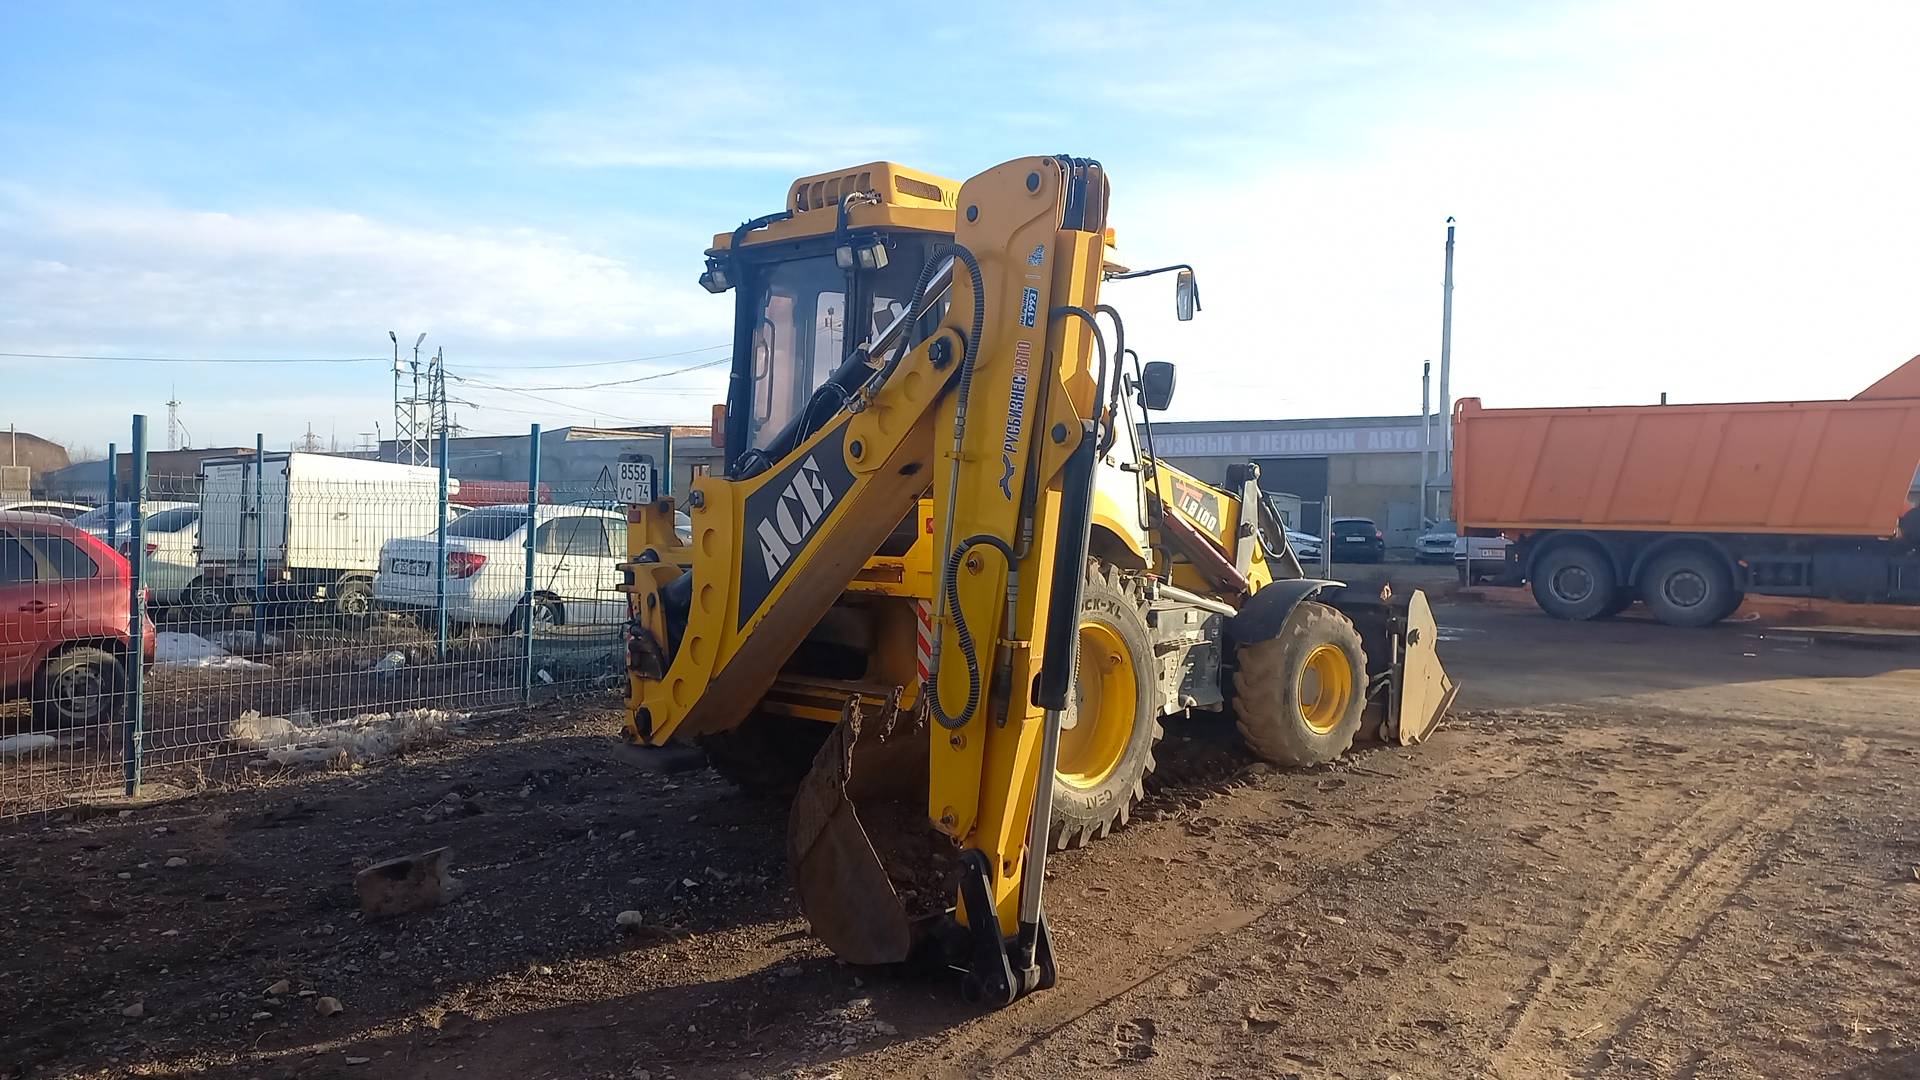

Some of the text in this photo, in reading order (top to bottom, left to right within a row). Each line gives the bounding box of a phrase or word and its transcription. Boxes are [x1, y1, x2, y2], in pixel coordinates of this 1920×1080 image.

[1004, 341, 1032, 453] РУСБИЗНЕСАВТО
[1155, 435, 1233, 454] РУЗОВЫХ
[1368, 430, 1417, 449] АВТО
[621, 464, 646, 481] 8558
[637, 484, 649, 498] 74
[757, 454, 834, 581] ACE
[1085, 789, 1113, 810] CEAT
